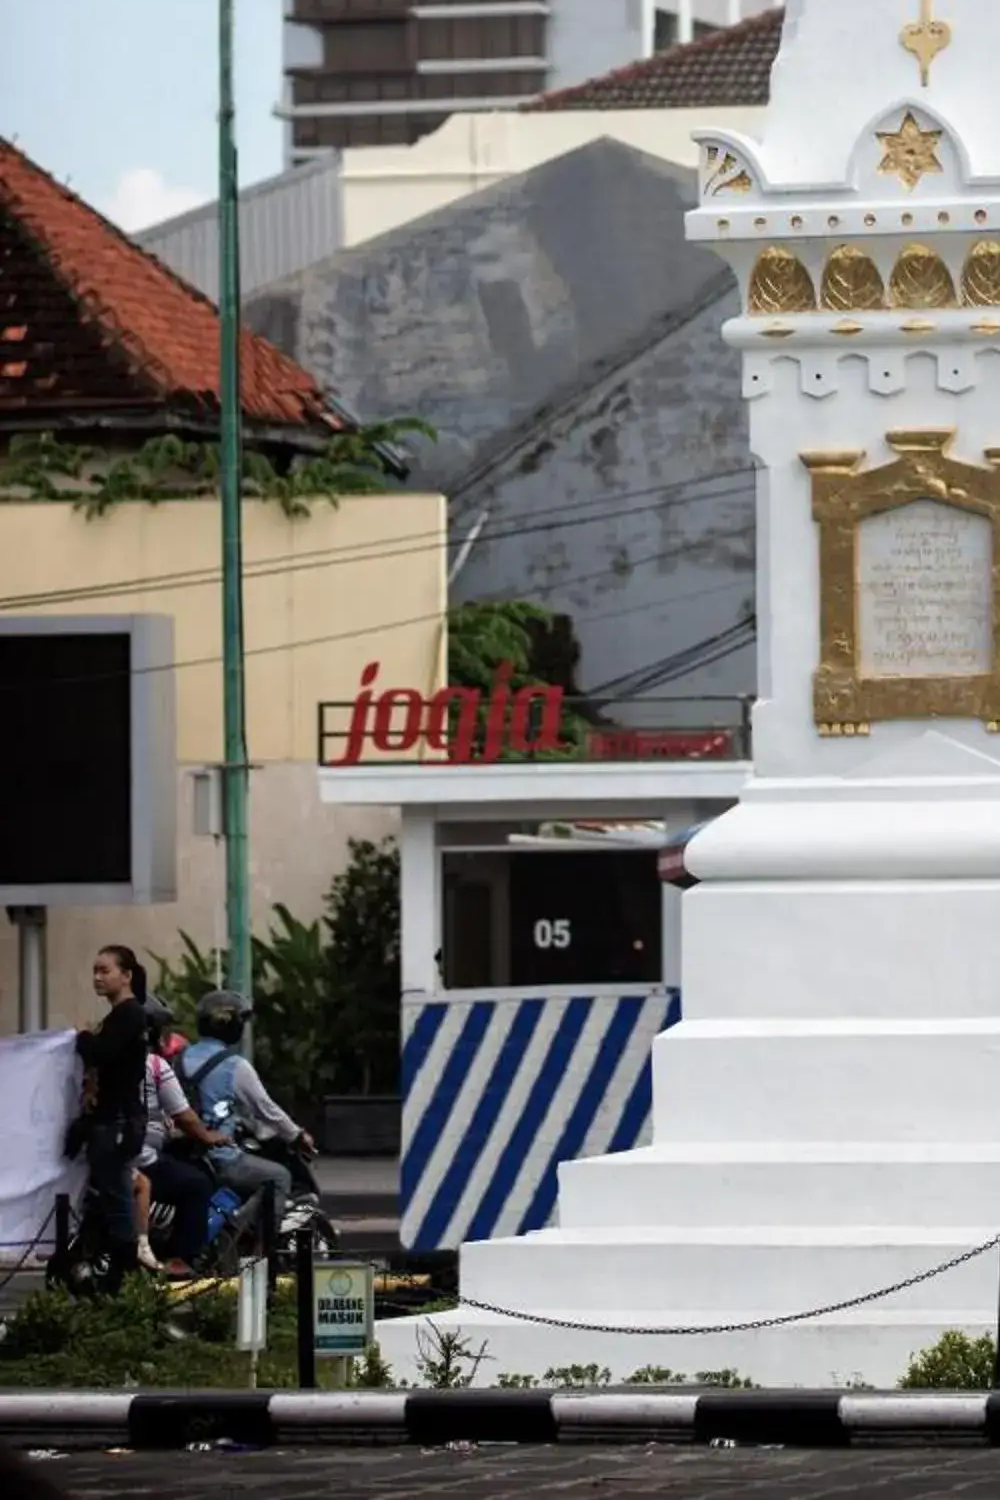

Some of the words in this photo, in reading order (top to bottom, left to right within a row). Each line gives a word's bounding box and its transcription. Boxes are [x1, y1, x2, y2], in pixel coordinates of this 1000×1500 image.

[329, 661, 568, 768] jogja
[534, 918, 571, 948] 05
[318, 1311, 364, 1325] MASUK
